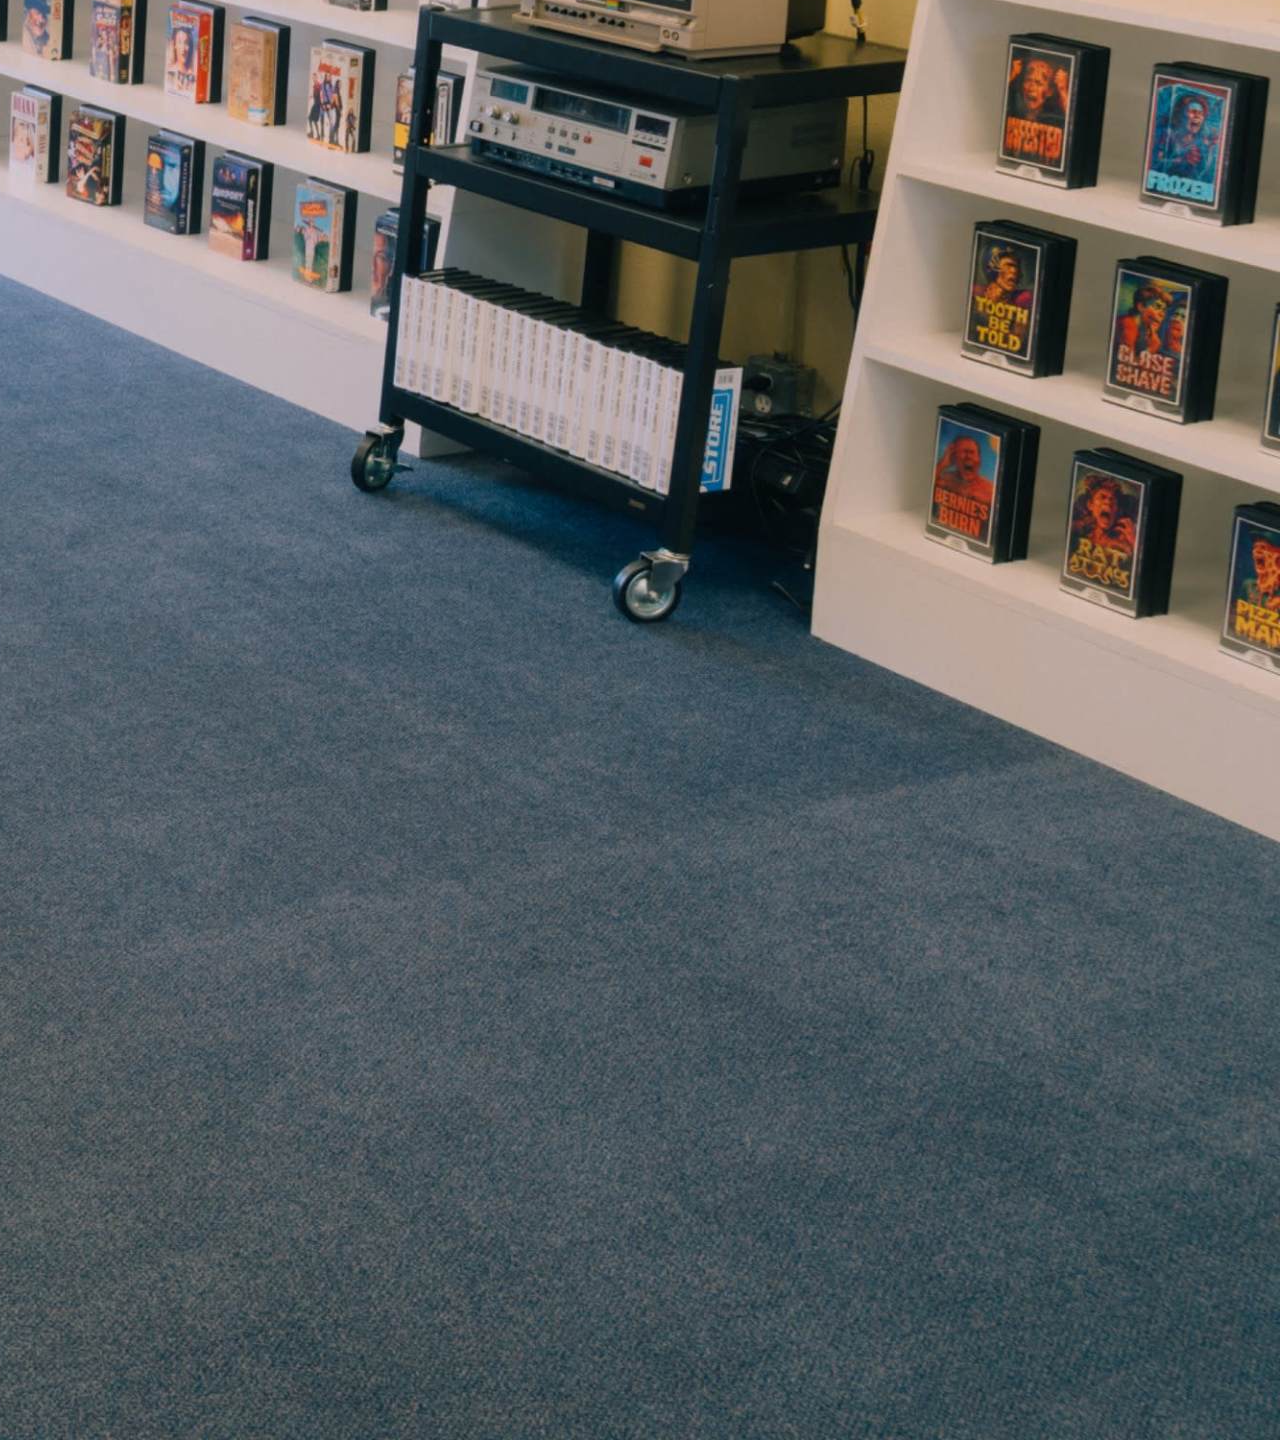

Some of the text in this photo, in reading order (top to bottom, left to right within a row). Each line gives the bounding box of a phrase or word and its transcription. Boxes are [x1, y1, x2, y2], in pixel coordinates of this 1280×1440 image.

[1147, 169, 1214, 203] FROZEN
[975, 295, 1029, 325] TOOTH
[989, 315, 1010, 333] BE
[976, 325, 1021, 352] TOLD
[1115, 363, 1172, 396] SHAVE
[703, 402, 724, 474] STORE
[938, 506, 980, 539] BURN
[1076, 537, 1128, 565] RAT
